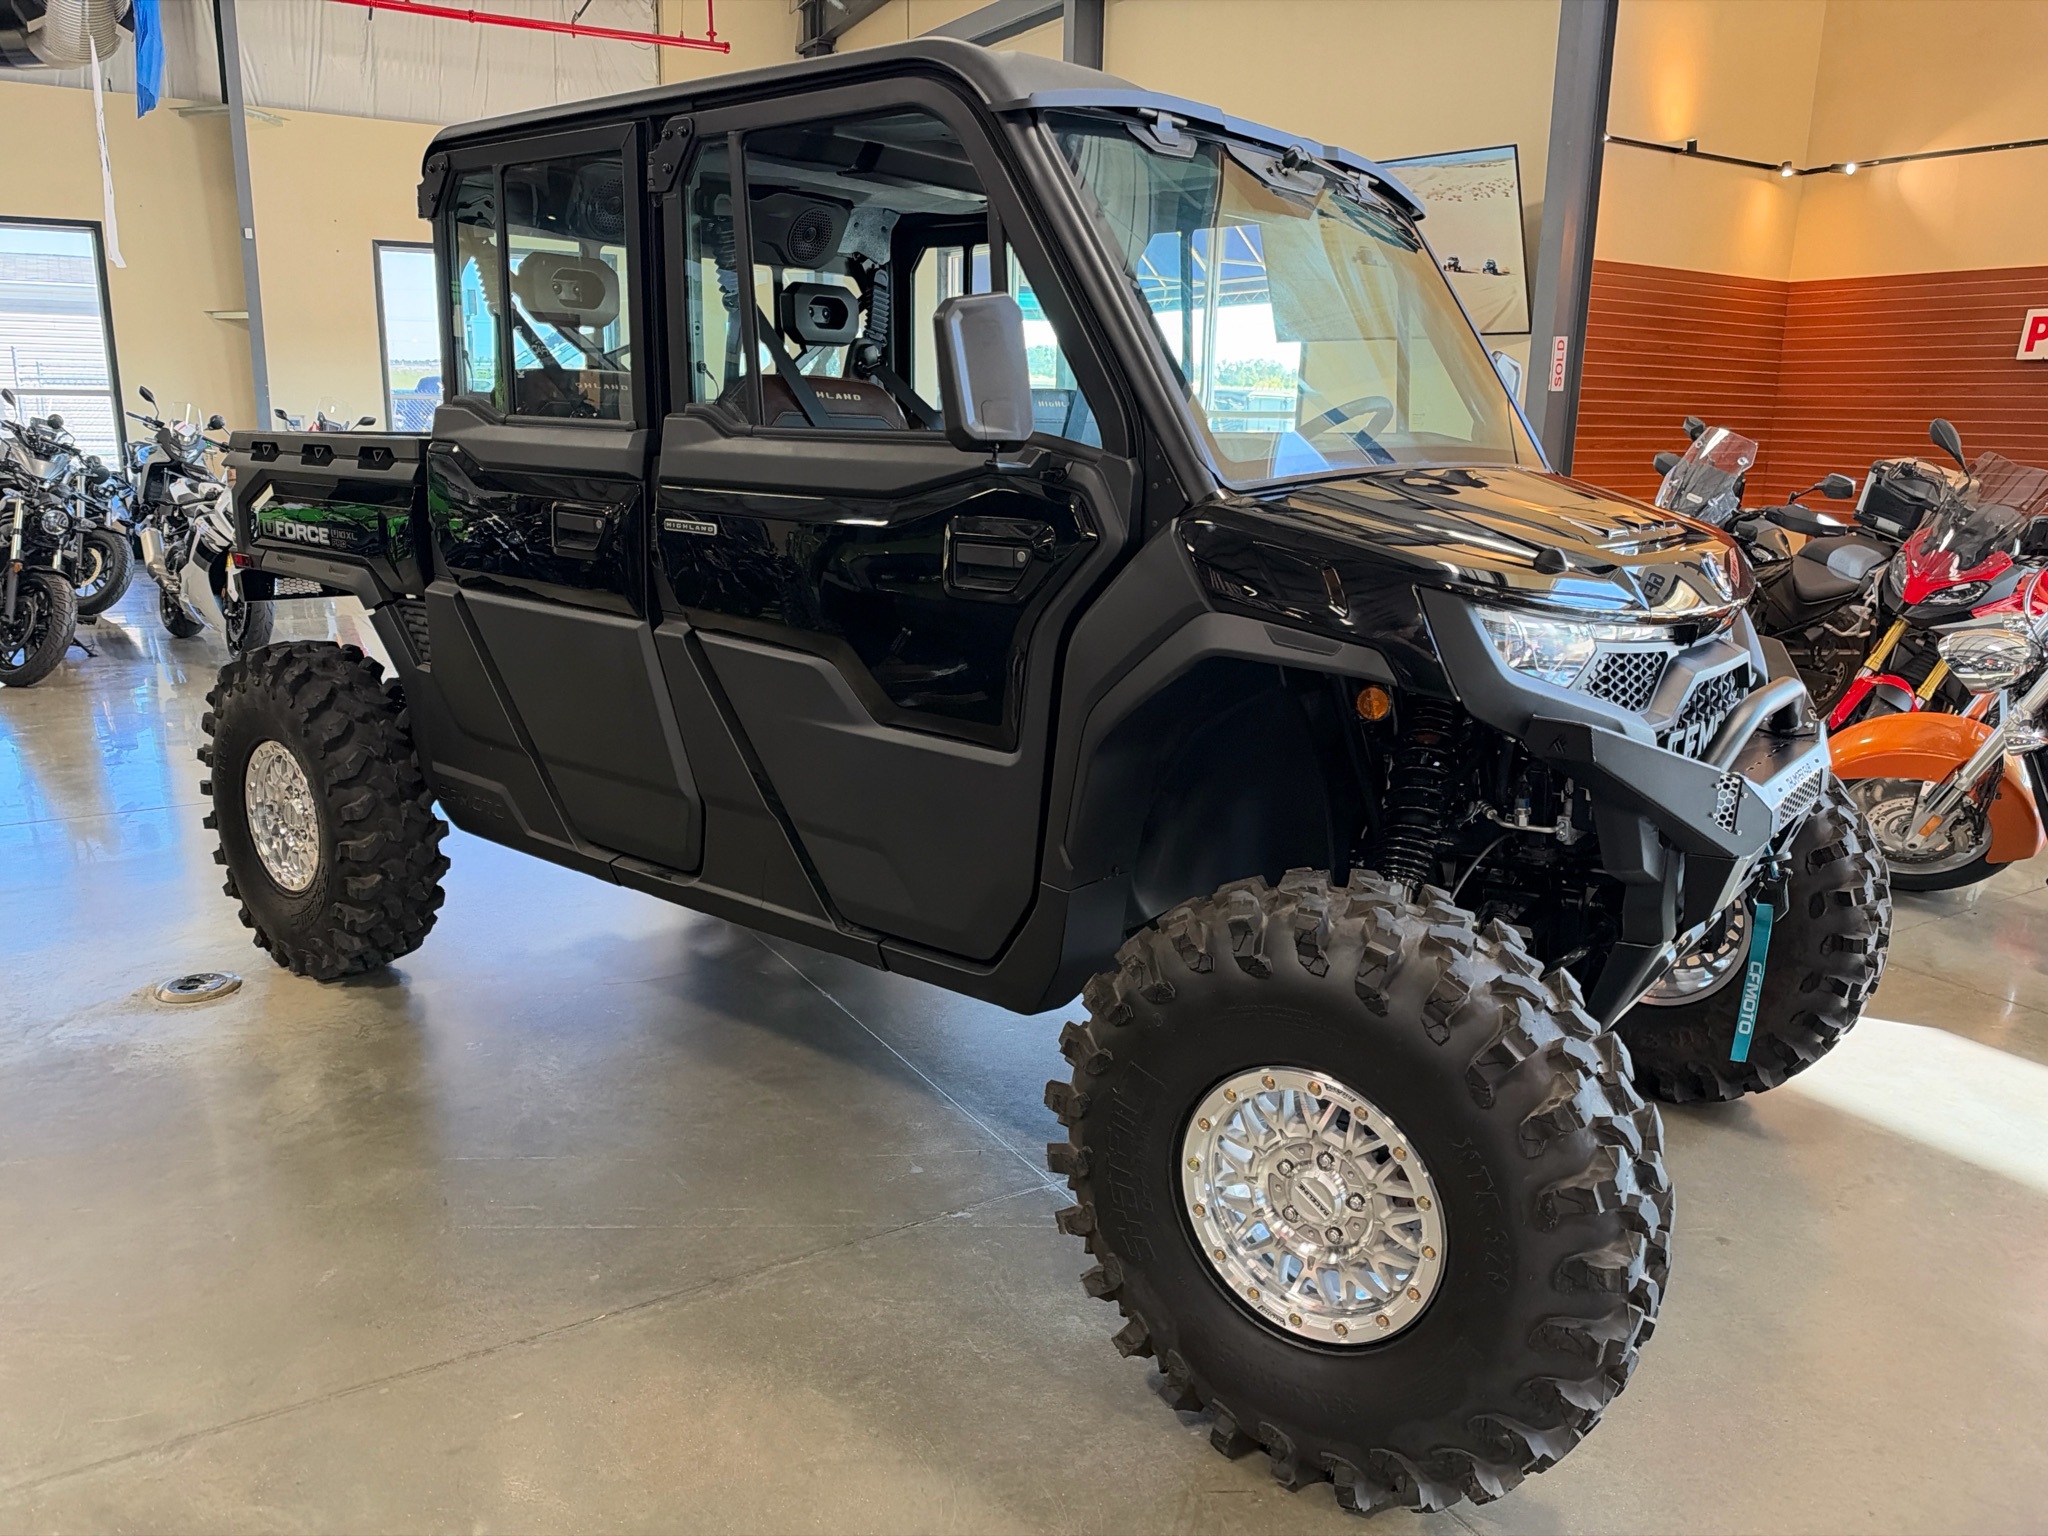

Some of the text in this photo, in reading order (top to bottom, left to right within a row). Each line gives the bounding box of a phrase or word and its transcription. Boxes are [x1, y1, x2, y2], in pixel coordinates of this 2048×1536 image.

[1554, 339, 1565, 387] SOLD
[815, 390, 862, 401] HLAND
[666, 521, 714, 532] HIGHLAND
[1738, 960, 1763, 1036] CFMOTO
[1299, 1183, 1330, 1217] RACELINE
